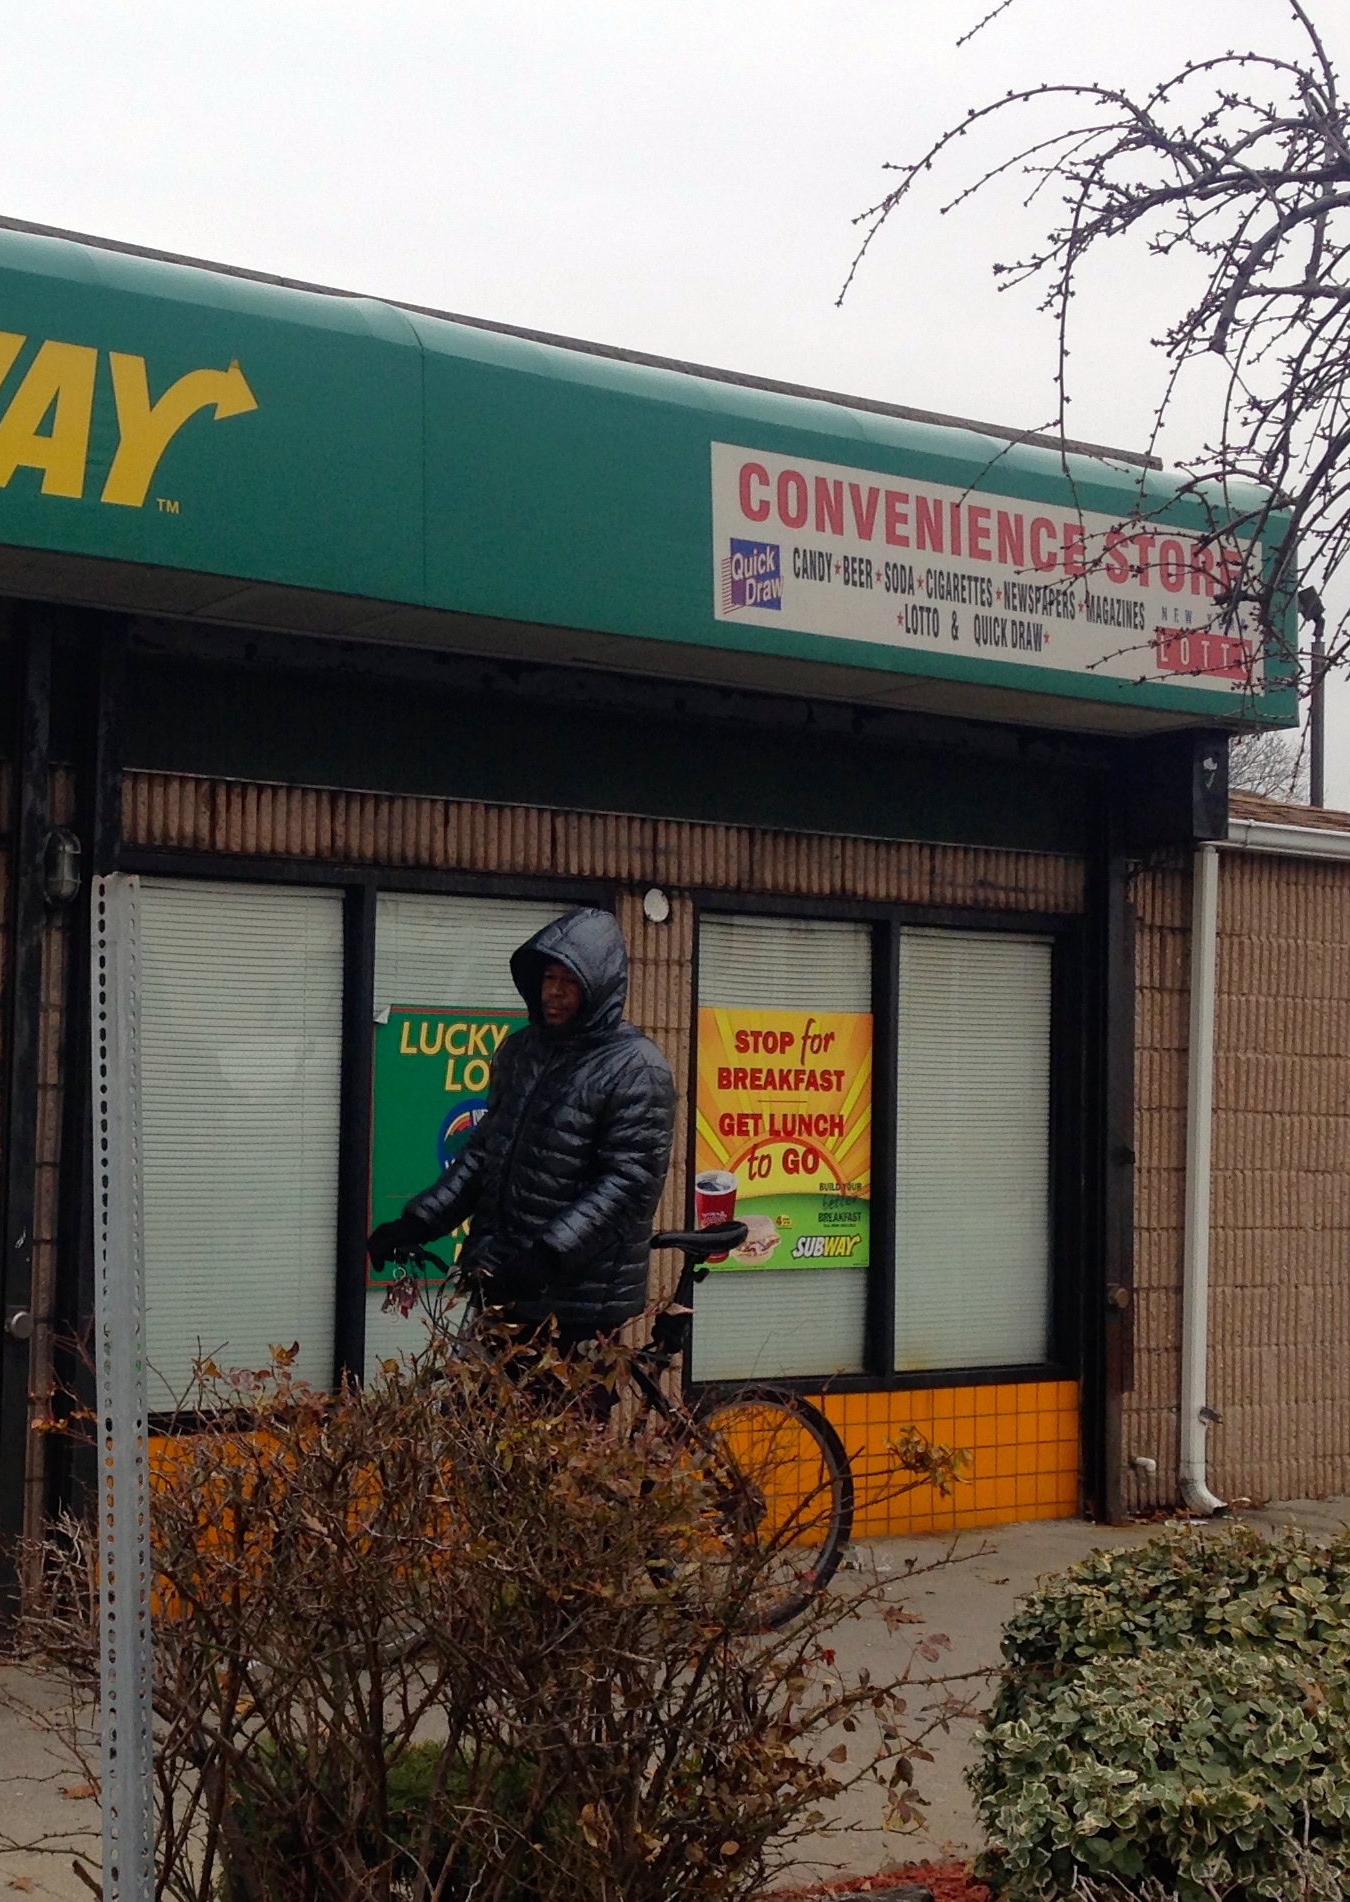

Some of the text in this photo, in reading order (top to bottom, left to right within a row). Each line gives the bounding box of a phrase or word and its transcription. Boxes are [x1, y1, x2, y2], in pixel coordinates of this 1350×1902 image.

[738, 461, 1087, 576] CONVENIENCE
[731, 545, 776, 581] Quick
[745, 576, 784, 606] Draw
[792, 547, 1145, 631] CANDY BEER SODA CIGARETTES NEWSPAPERS MAGAZINES
[904, 603, 1044, 652] LOTTO & QUICK DRAW
[1161, 605, 1193, 625] NEW
[400, 1020, 511, 1056] LUCKY
[735, 1018, 836, 1066] STOP for
[444, 1059, 492, 1092] LO
[717, 1067, 846, 1092] BREAKFAST
[718, 1112, 845, 1138] GET LUNCH
[747, 1143, 820, 1181] to GO
[792, 1233, 863, 1260] SUBWAY
